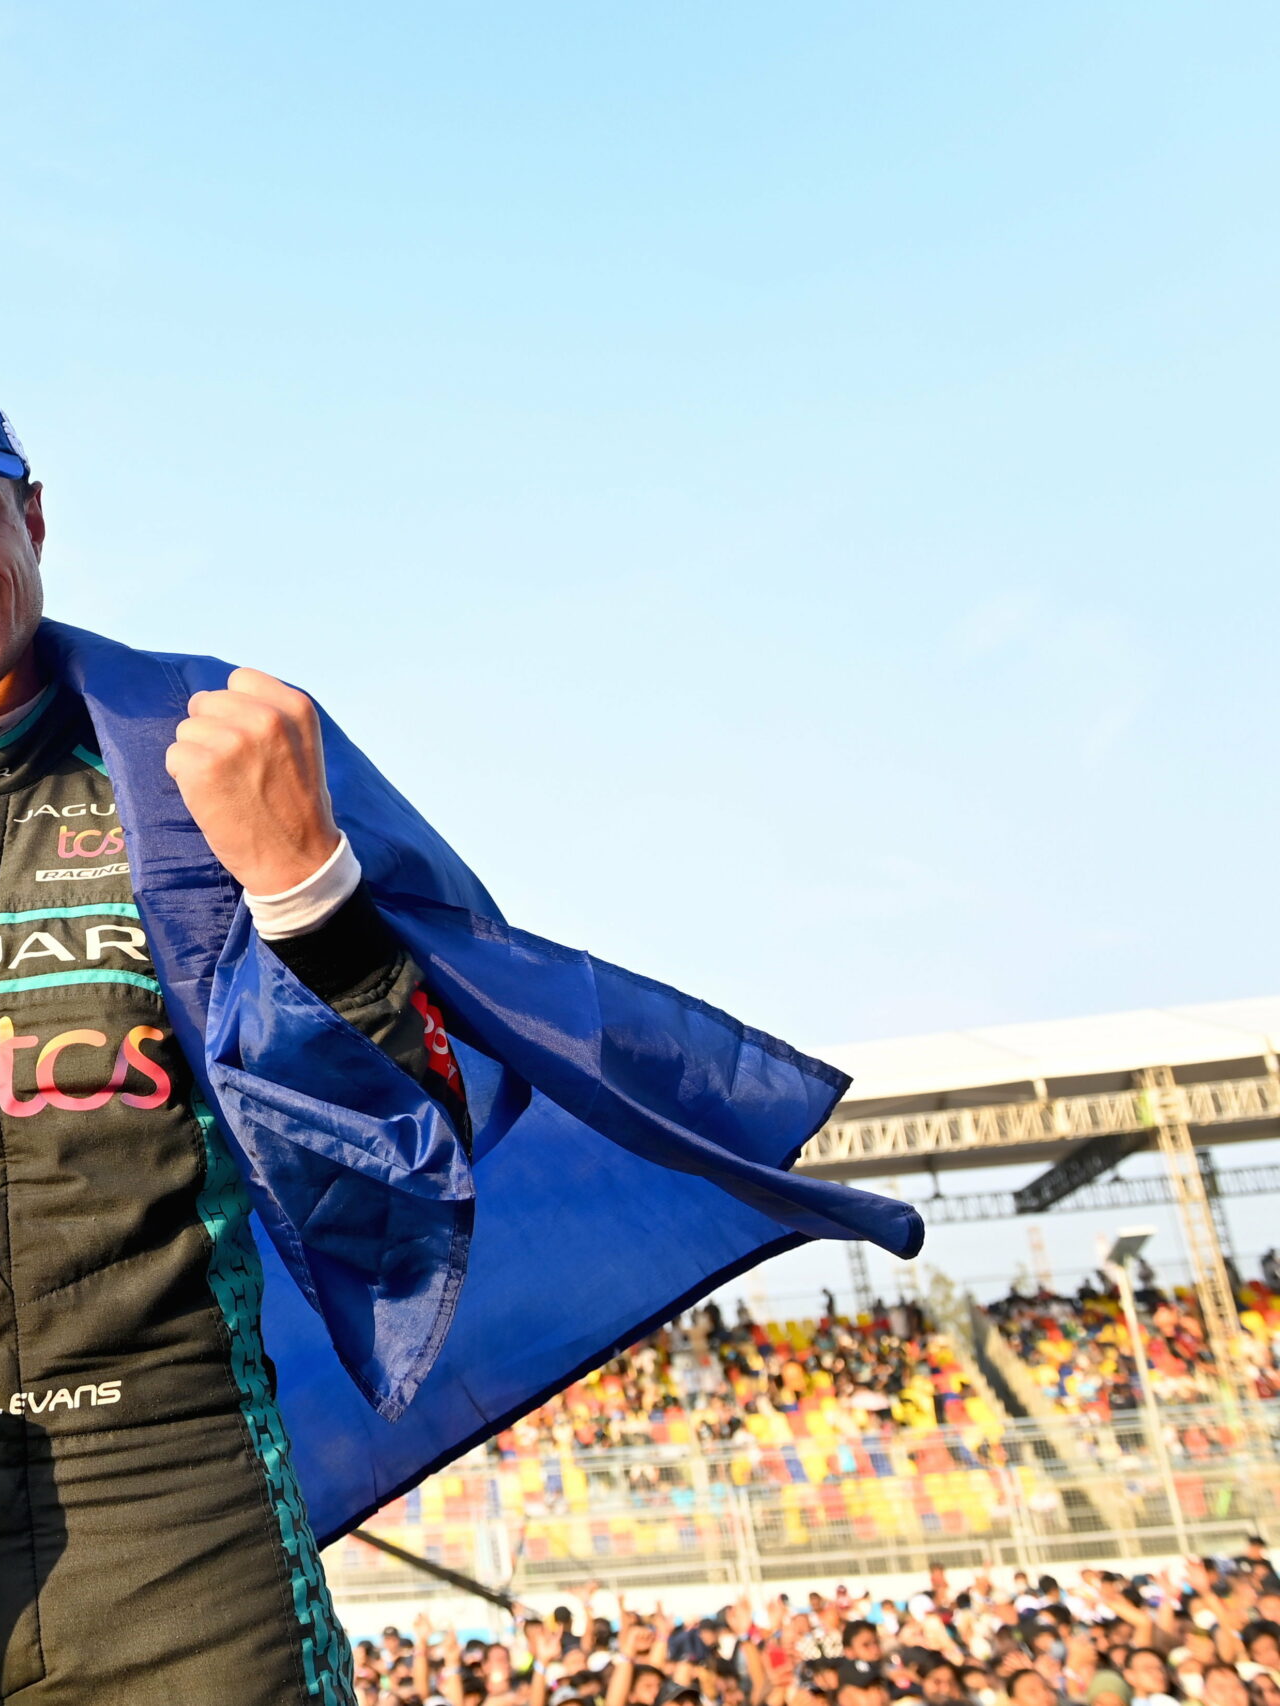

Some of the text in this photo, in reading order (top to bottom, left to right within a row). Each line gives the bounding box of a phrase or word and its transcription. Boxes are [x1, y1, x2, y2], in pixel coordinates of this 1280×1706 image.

[13, 803, 118, 823] JAGU
[57, 825, 125, 859] tcs
[40, 864, 129, 880] RACING
[9, 1380, 122, 1415] EVANS
